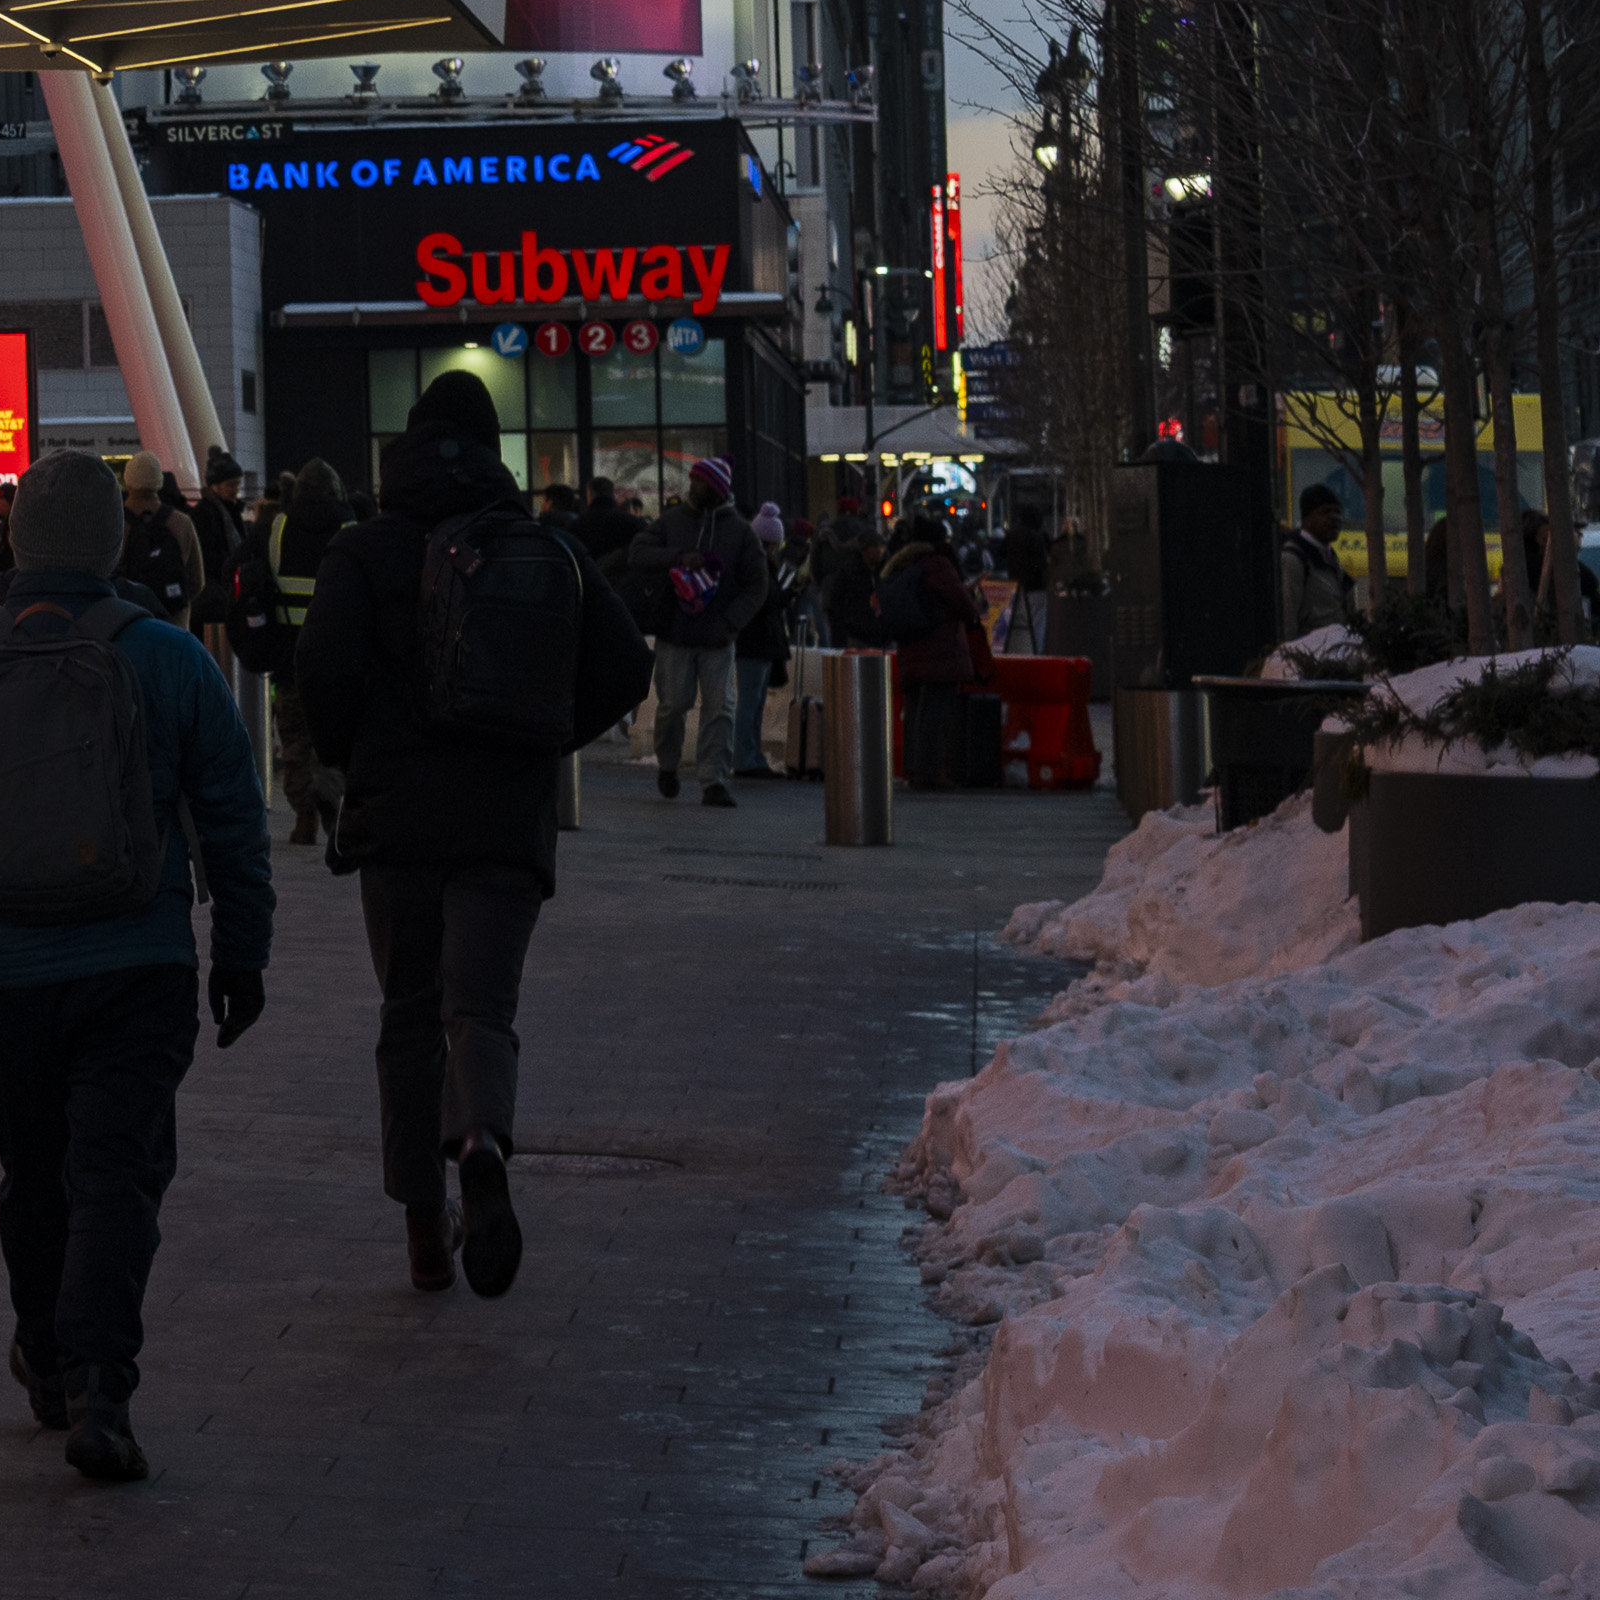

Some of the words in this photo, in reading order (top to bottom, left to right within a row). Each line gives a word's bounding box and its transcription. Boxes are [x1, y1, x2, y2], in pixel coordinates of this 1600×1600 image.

[167, 124, 284, 143] SILVERCAST
[228, 161, 340, 191] BANK
[351, 158, 402, 188] OF
[412, 153, 600, 187] AMERICA
[416, 230, 731, 315] Subway
[544, 327, 559, 351] 1
[587, 326, 607, 350] 2
[630, 324, 650, 348] 3
[667, 322, 699, 349] MTA
